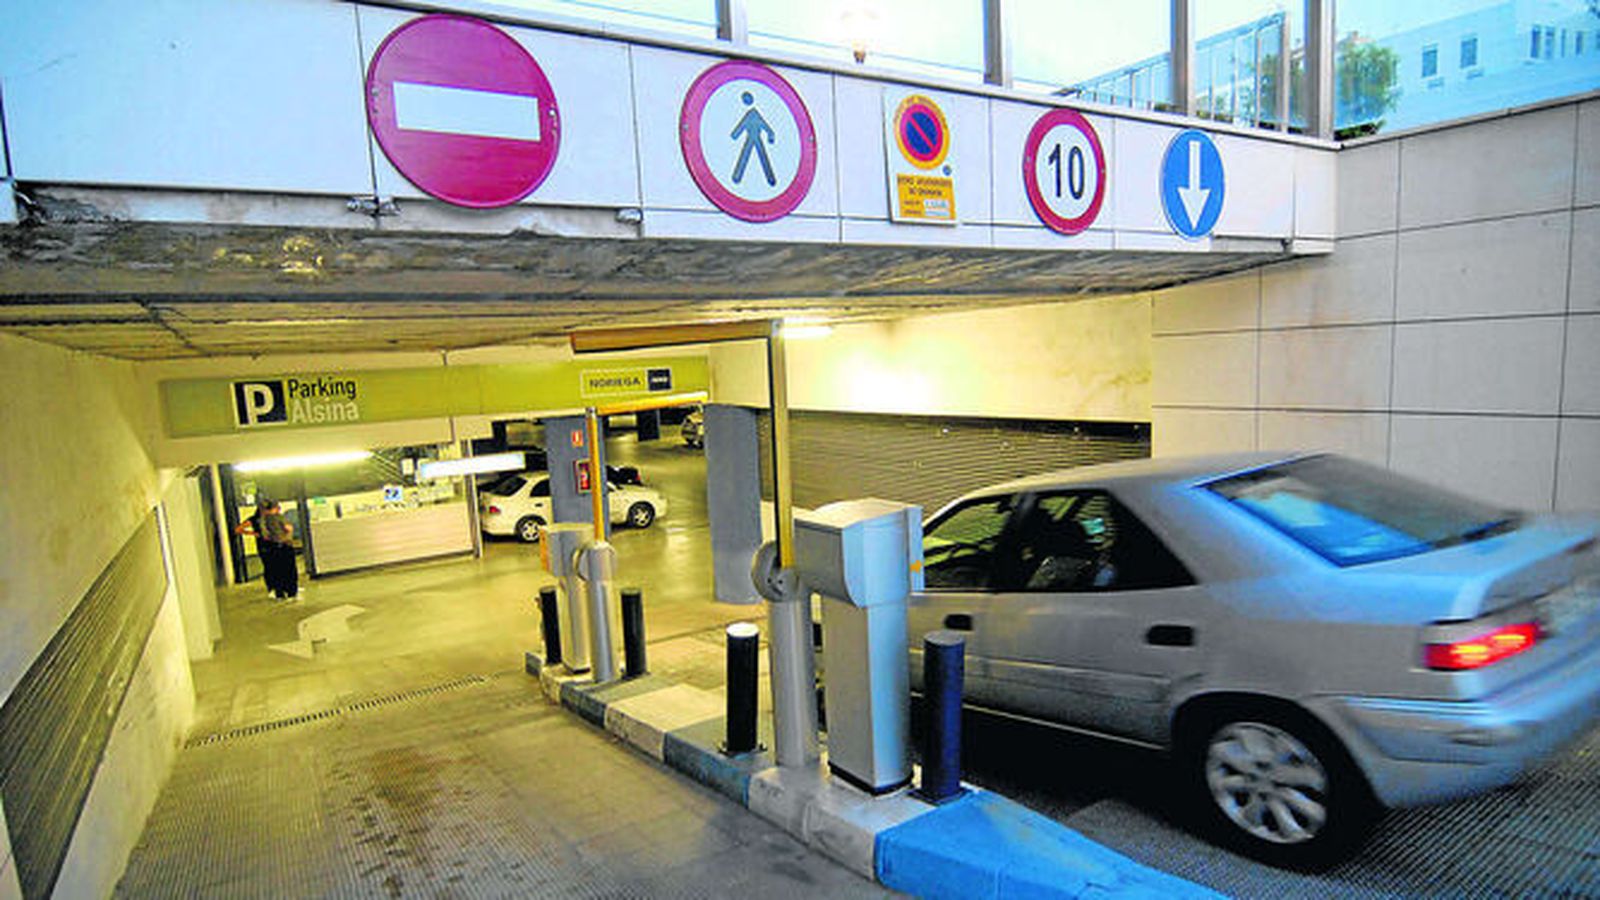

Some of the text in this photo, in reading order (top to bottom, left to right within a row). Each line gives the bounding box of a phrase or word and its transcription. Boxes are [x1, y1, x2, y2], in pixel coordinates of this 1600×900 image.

[1047, 143, 1086, 200] 10
[242, 383, 275, 425] P
[287, 376, 357, 400] Parking
[291, 400, 360, 424] Alsina
